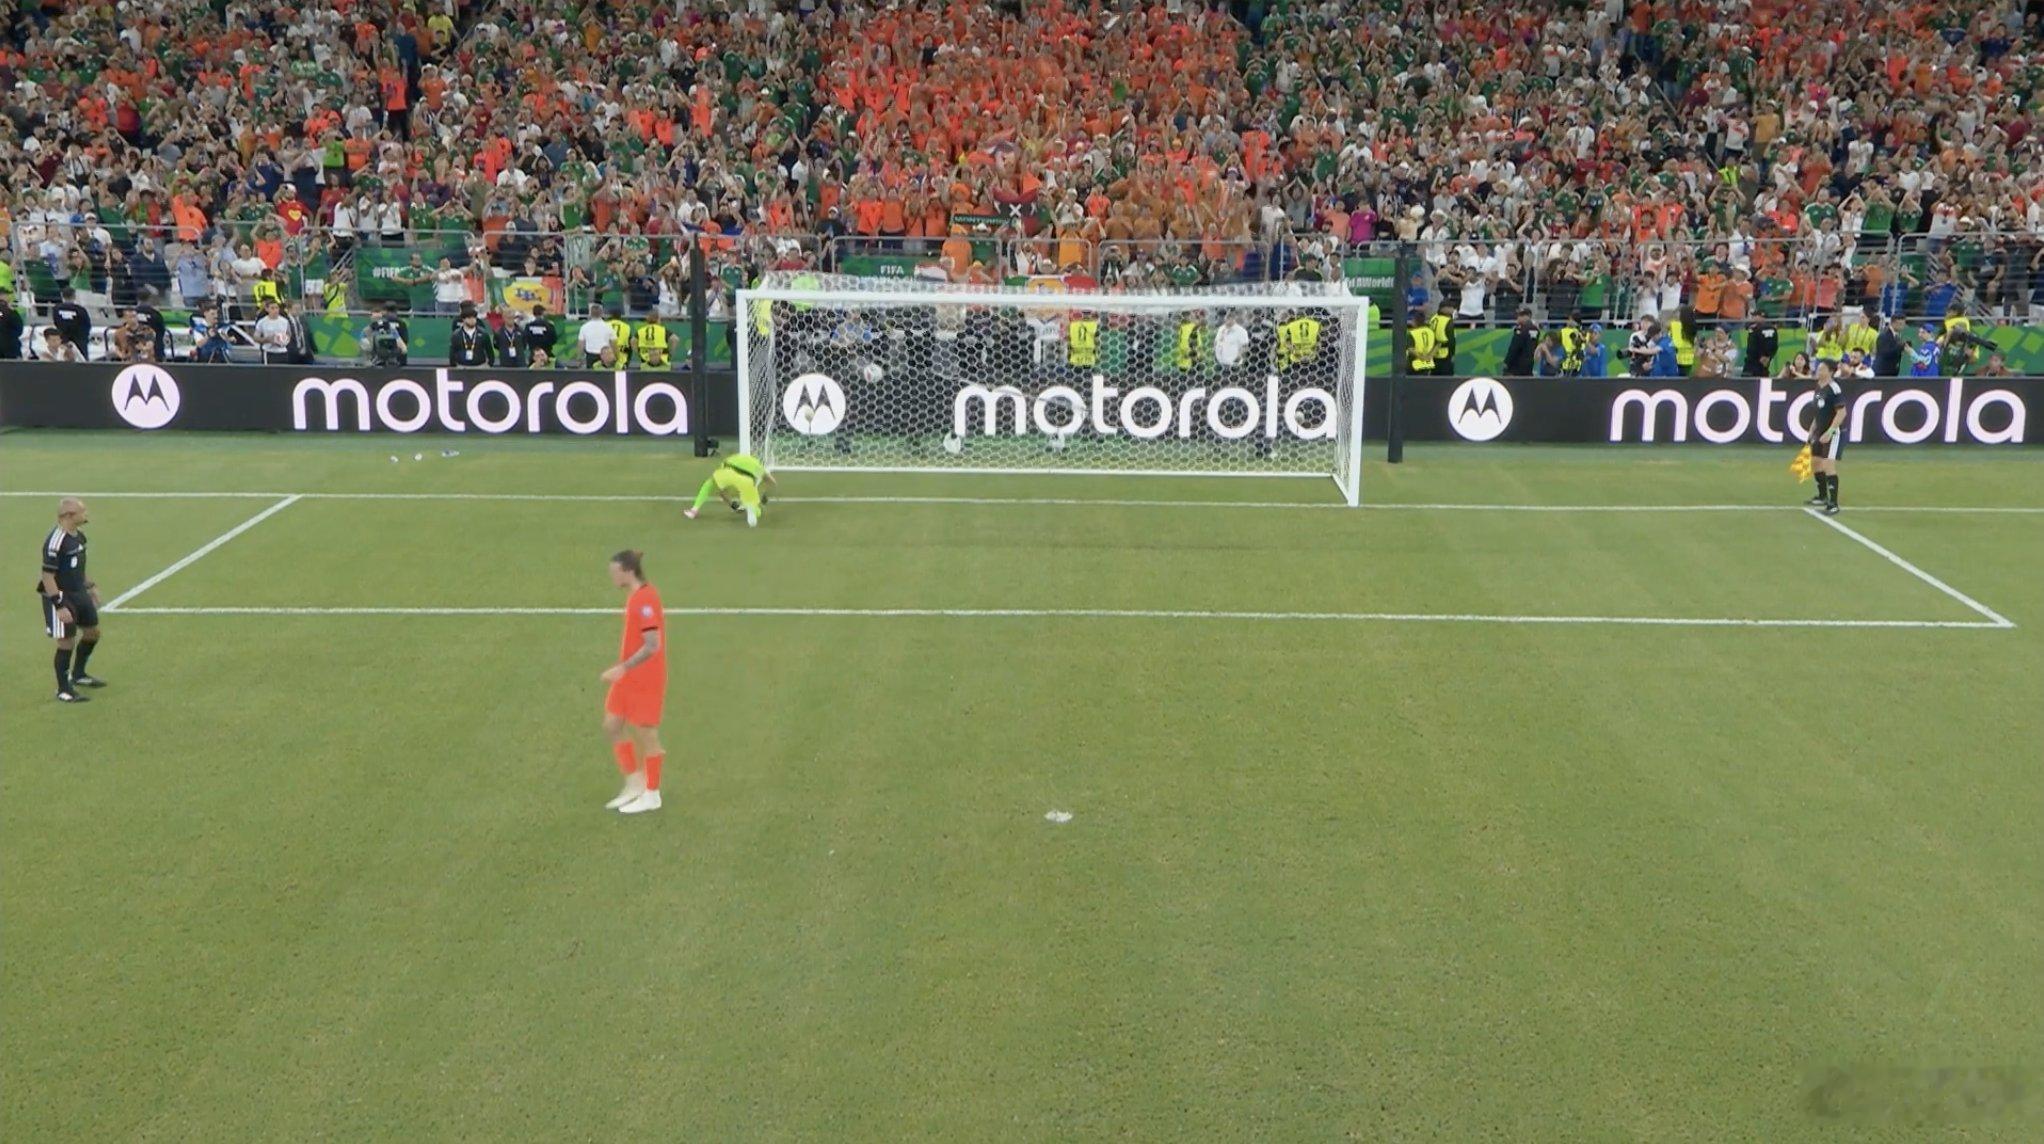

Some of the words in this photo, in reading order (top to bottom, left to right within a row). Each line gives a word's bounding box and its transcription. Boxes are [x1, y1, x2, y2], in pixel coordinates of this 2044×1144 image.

[880, 264, 905, 275] FIFA
[292, 367, 689, 435] motorola
[954, 373, 1338, 441] motorola
